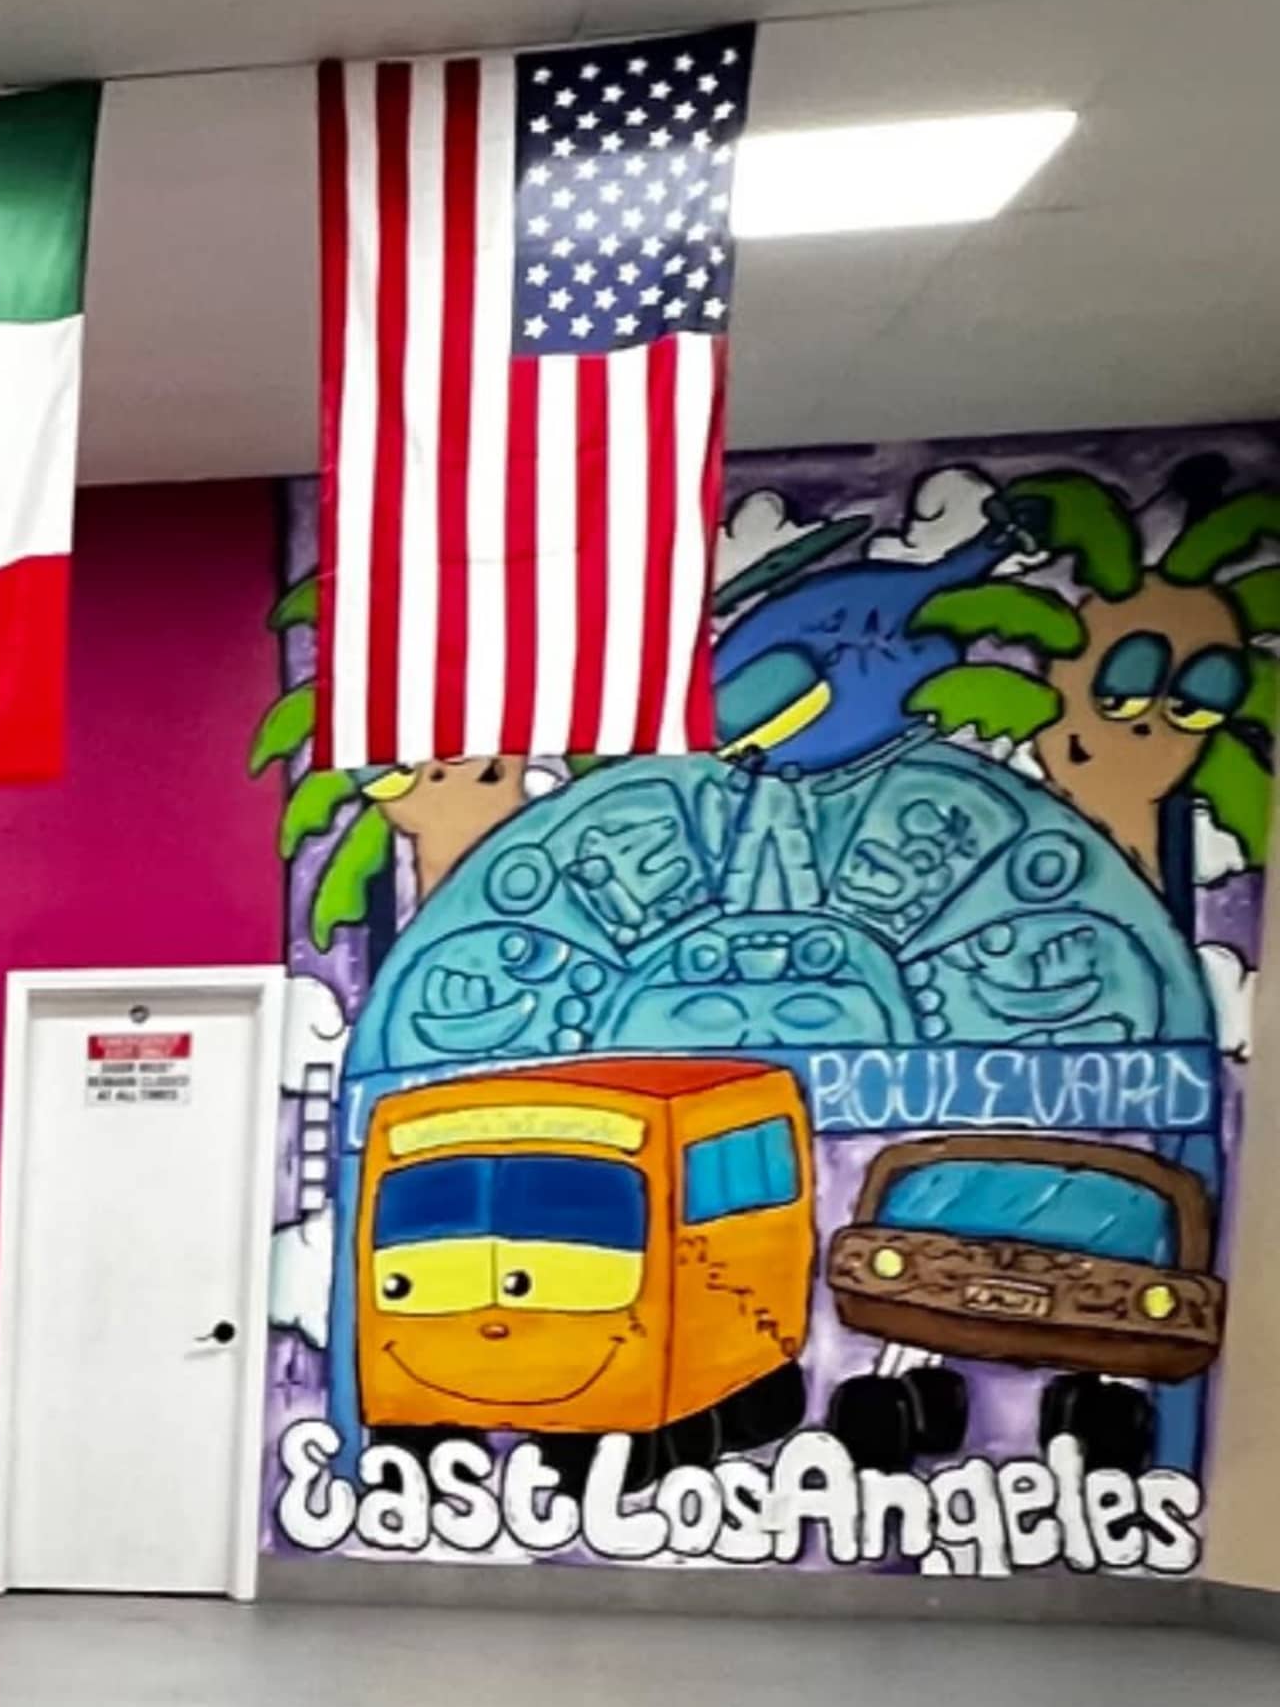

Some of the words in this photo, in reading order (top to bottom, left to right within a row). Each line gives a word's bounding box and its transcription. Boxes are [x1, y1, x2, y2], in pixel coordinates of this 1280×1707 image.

[808, 1048, 1212, 1130] BOULEVARD
[278, 1418, 580, 1552] East
[581, 1431, 774, 1563] Los
[771, 1428, 1204, 1576] Angeles
